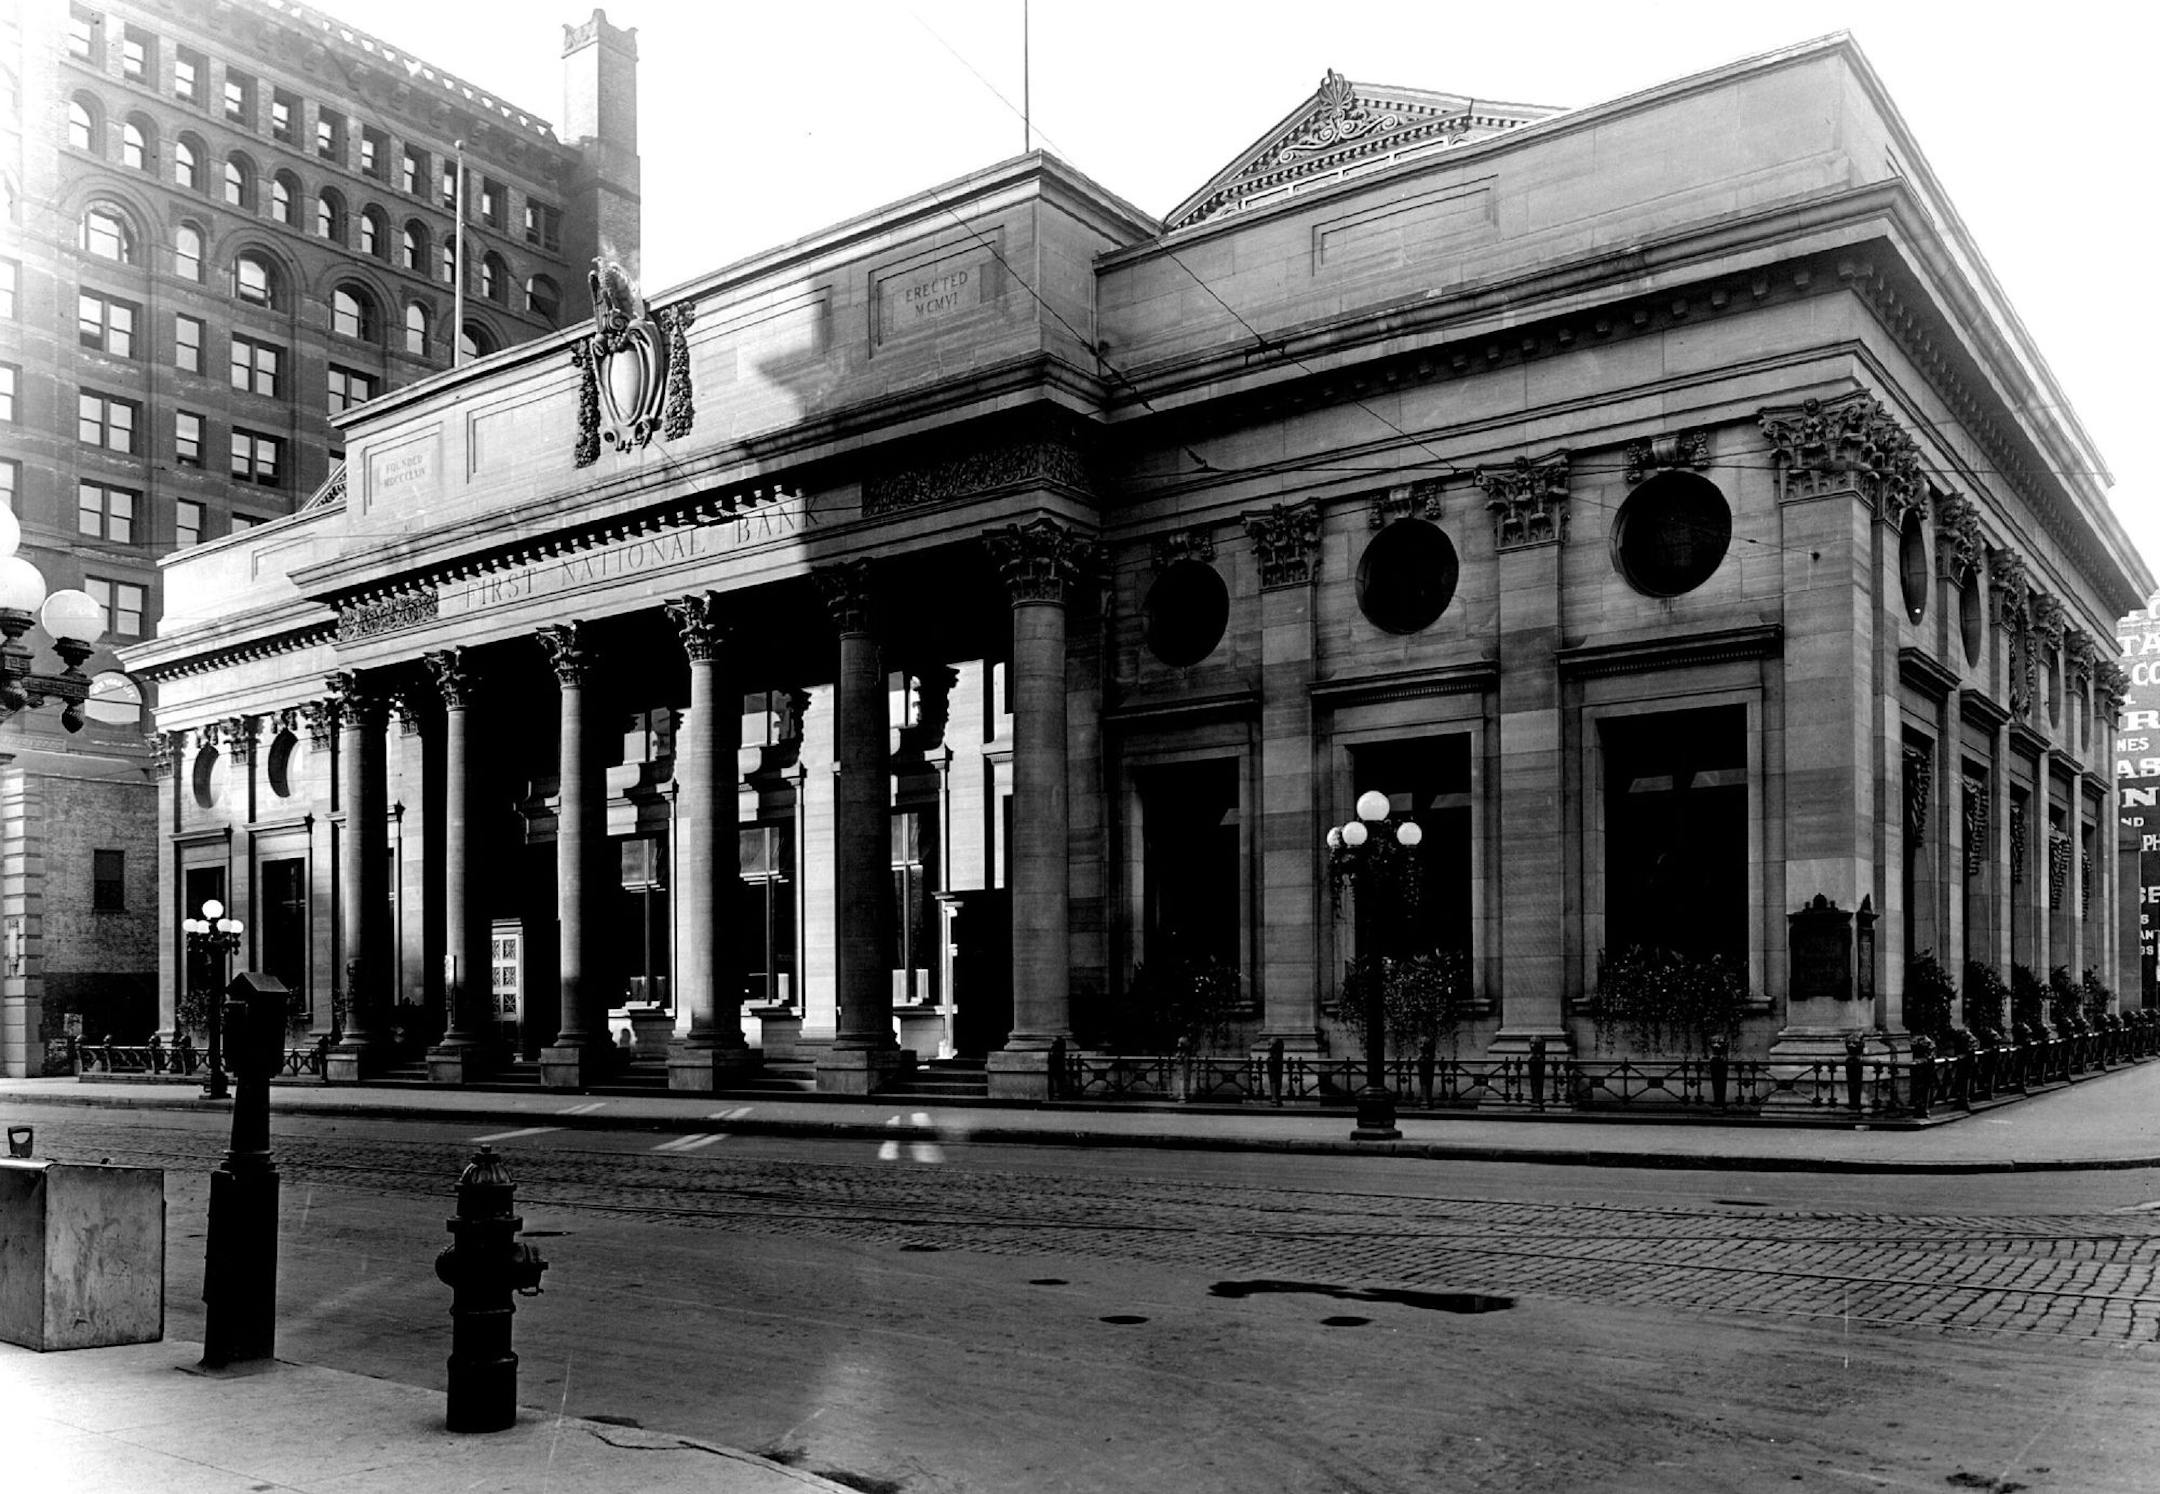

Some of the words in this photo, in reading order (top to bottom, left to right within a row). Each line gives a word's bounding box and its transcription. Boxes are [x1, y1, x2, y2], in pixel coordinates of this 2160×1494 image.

[906, 271, 968, 302] ERECTED
[466, 566, 537, 608] FIRST
[561, 528, 706, 587] NATIONAL
[735, 495, 819, 544] BANK
